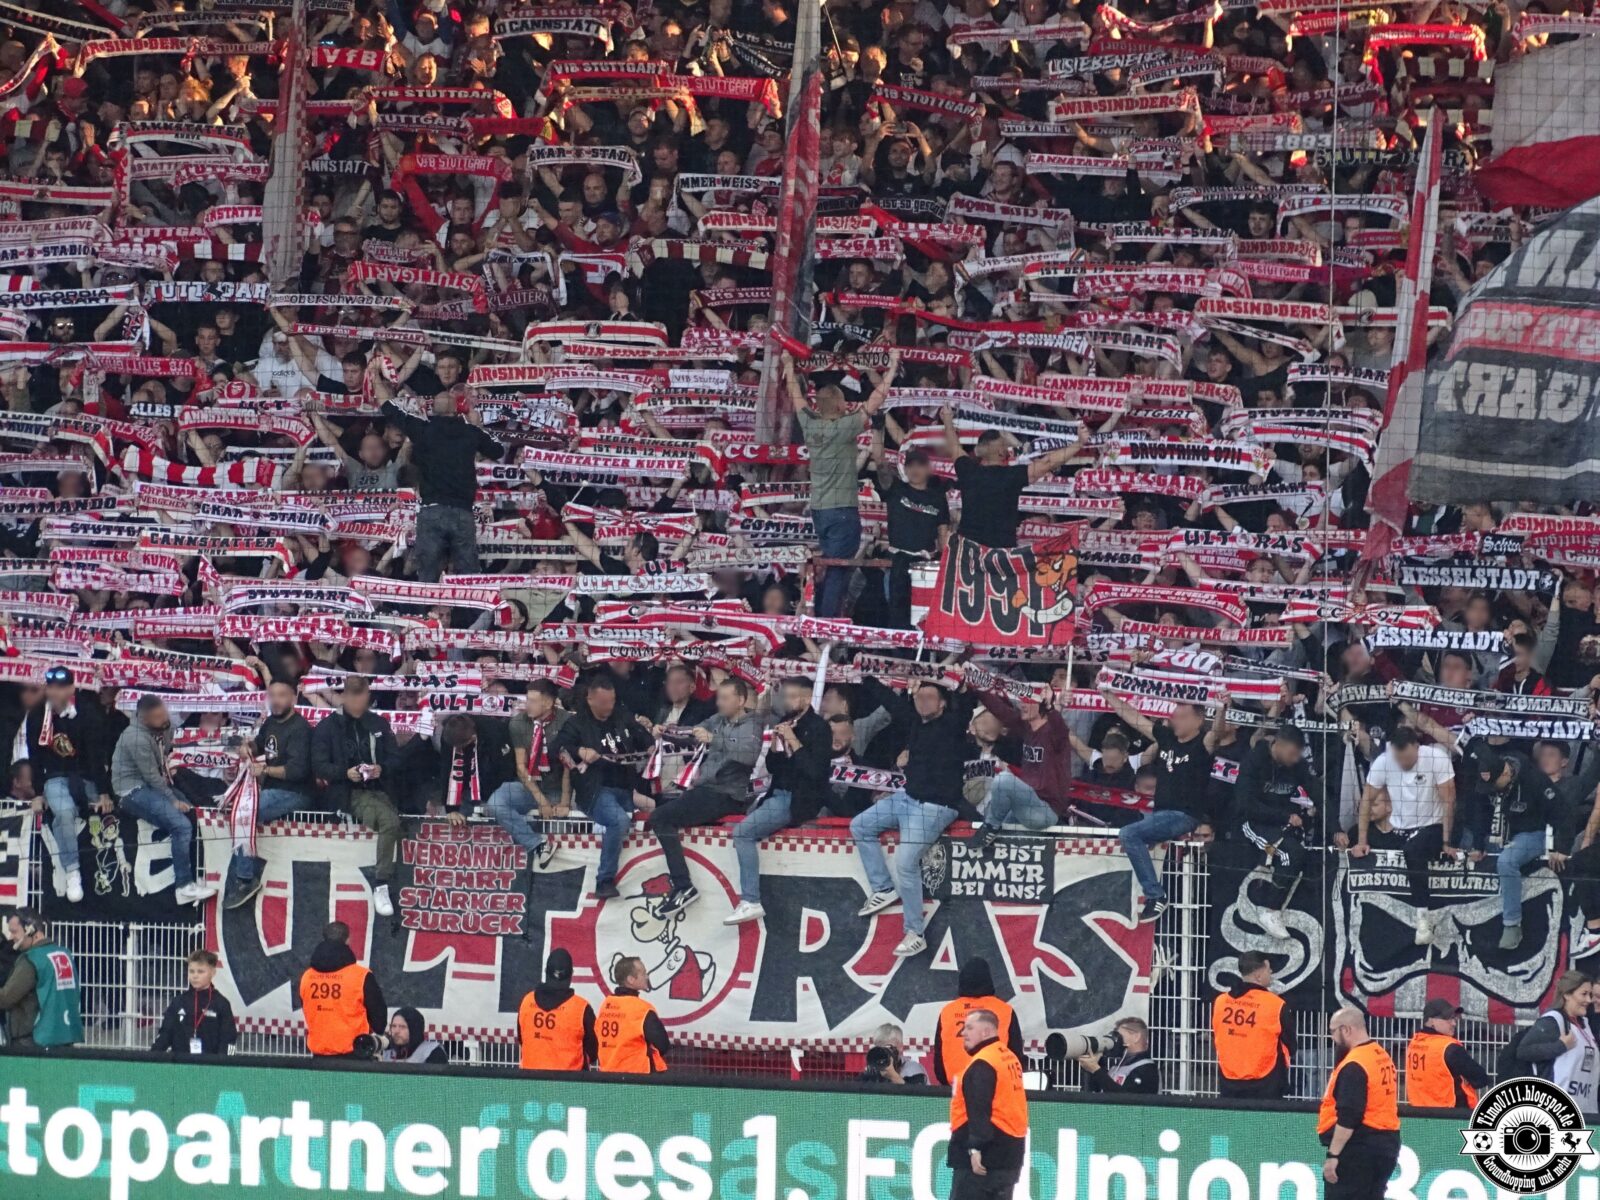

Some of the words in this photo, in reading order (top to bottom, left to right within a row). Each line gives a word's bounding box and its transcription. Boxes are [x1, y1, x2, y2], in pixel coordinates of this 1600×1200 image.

[322, 48, 378, 66] VfB
[553, 63, 578, 74] VfB
[1062, 101, 1093, 116] WIR
[1097, 97, 1135, 113] SIND
[1139, 95, 1171, 110] DER
[302, 160, 372, 176] ANNSTATT
[721, 177, 761, 189] WEISS
[1114, 226, 1164, 237] ECKAR
[366, 266, 479, 292] STUTTGART
[0, 289, 110, 301] CONCORDIA
[498, 366, 537, 381] SIND
[1298, 364, 1387, 383] STUTTGAR
[975, 380, 1066, 402] CANNSTATTER
[1080, 394, 1124, 408] KURVE
[1042, 377, 1132, 393] CANNSTATTER
[1144, 382, 1187, 397] KURVE
[131, 404, 172, 417] ALLES
[524, 448, 631, 467] CANNSTATTER
[636, 459, 686, 470] KURVE
[1131, 443, 1210, 461] BRUSTRING
[4, 498, 117, 513] OMMANDO
[740, 519, 815, 534] COMMA
[151, 531, 276, 548] CANNSTATTER
[1401, 566, 1541, 591] KESSELSTADT
[940, 537, 1047, 639] 1991
[1377, 609, 1404, 623] 97
[589, 624, 667, 639] Cannst
[1121, 620, 1221, 640] CANNSTATTER
[1238, 628, 1287, 642] KURVE
[1111, 672, 1209, 702] COMMANDO
[182, 751, 233, 766] COMM
[416, 823, 512, 844] JEDER
[402, 844, 527, 870] VERBANNTE
[994, 843, 1046, 862] BIST
[414, 867, 516, 890] KEHRT
[951, 860, 1044, 883] IMMER
[951, 881, 985, 896] BEI
[993, 882, 1046, 899] UNS!
[1451, 873, 1499, 891] ULTRAS
[399, 887, 526, 913] STÄRKER
[401, 908, 523, 935] ZURÜCK
[310, 983, 341, 1000] 298
[533, 1012, 556, 1030] 66
[1222, 1007, 1256, 1028] 264
[601, 1020, 619, 1038] 89
[1407, 1053, 1426, 1071] 191
[528, 1107, 713, 1200] des
